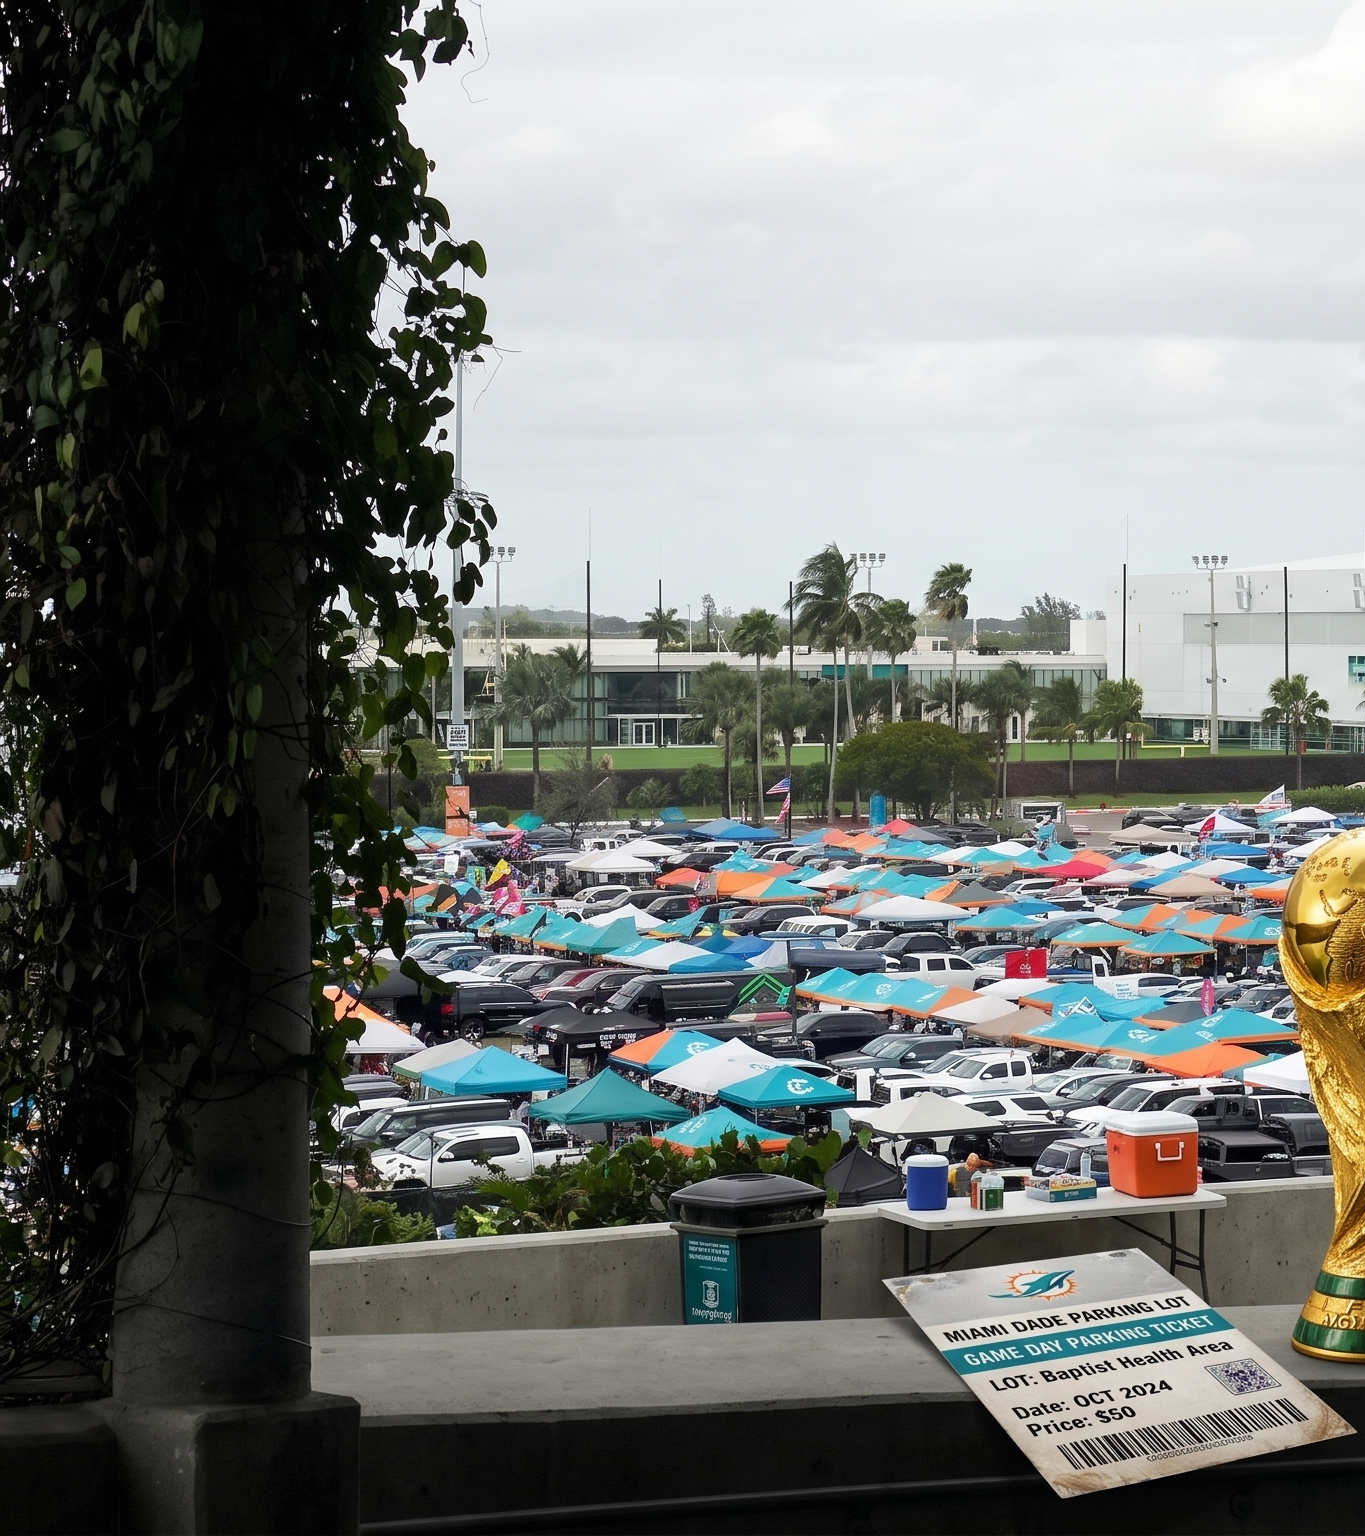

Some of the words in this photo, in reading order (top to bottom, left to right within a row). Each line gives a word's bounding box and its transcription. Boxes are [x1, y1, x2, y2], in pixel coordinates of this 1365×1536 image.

[943, 1323, 1009, 1343] MIAMI
[1010, 1315, 1068, 1333] DADE
[1067, 1302, 1154, 1324] PARKING
[1153, 1296, 1190, 1310] LOT
[963, 1346, 1024, 1366] GAME
[1024, 1339, 1063, 1356] DAY
[1065, 1326, 1151, 1349] PARKING
[1149, 1315, 1214, 1335] TICKET
[989, 1374, 1038, 1391] LOT:
[1039, 1360, 1117, 1383] Baptist
[1116, 1348, 1184, 1369] Health
[1186, 1341, 1234, 1357] Area
[1011, 1400, 1070, 1420] Date:
[1073, 1389, 1116, 1407] OCT
[1119, 1379, 1173, 1399] 2024
[1026, 1416, 1093, 1437] Price:
[1095, 1405, 1137, 1424] $50
